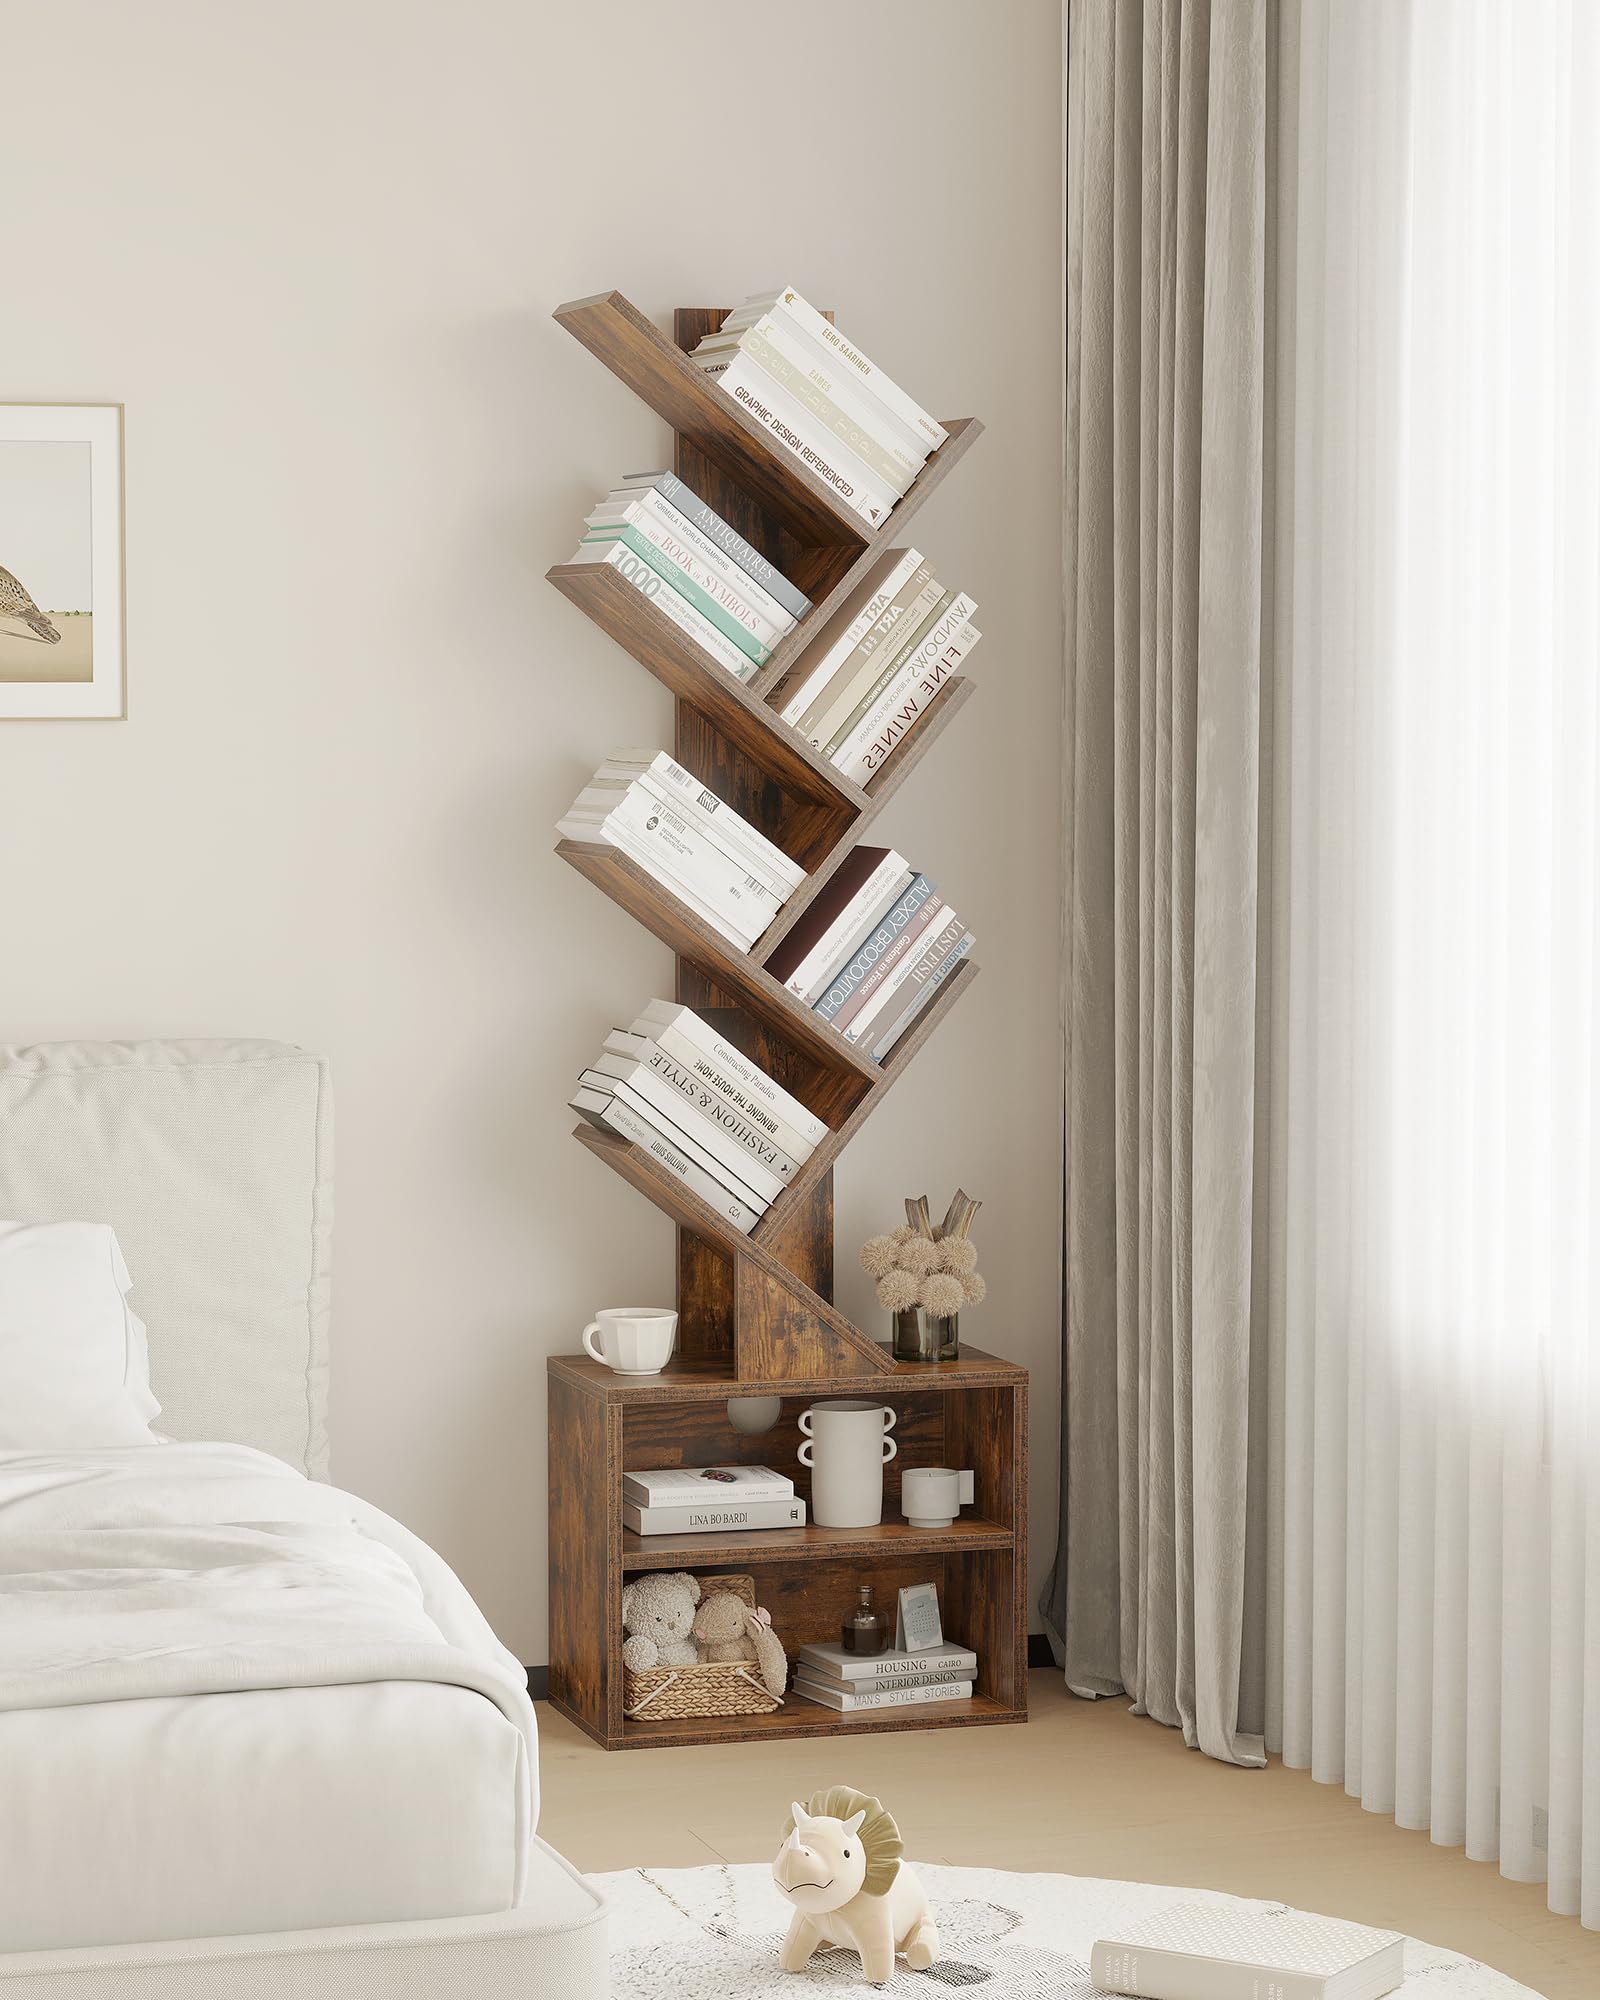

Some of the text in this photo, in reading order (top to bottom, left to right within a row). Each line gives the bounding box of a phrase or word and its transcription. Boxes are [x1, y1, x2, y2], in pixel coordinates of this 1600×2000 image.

[821, 327, 872, 376] EERO SAARINEN
[808, 369, 832, 392] EAMES
[734, 386, 771, 422] GRAPHIC
[769, 418, 804, 452] DESIGN
[800, 445, 854, 497] REFERENCED
[632, 533, 654, 555] TEXTILE
[652, 499, 680, 524] FORMULA
[680, 524, 702, 544] WORLD
[697, 541, 730, 571] CHAMPIONS
[696, 508, 775, 580] ANTIQUAIRES
[611, 550, 662, 597] 1000
[663, 539, 694, 573] BOOK
[702, 575, 760, 631] SYMBOLS
[884, 877, 933, 934] ALEXEY
[909, 946, 926, 965] URBAN
[923, 935, 935, 948] NEW
[932, 917, 966, 957] LOST
[826, 928, 893, 1016] BRODOVITCH
[859, 933, 911, 997] Gardens in France
[892, 963, 912, 986] HOUSING
[909, 949, 940, 985] FISH
[930, 936, 969, 985] MAKING IT
[713, 1043, 752, 1081] Constructing
[649, 1052, 778, 1164] FASHION & STYLE
[692, 1058, 779, 1134] BRINGING THE HOUSE HOME
[649, 1139, 690, 1176] LOUIS SULLIVAN
[726, 1204, 743, 1220] CCA
[689, 1513, 748, 1525] LINA BO BARDI
[876, 1660, 961, 1674] HOUSING CAIRO
[876, 1671, 957, 1691] INTERIOR DESIGN
[889, 1690, 915, 1702] STYLE
[925, 1686, 961, 1698] STORIES
